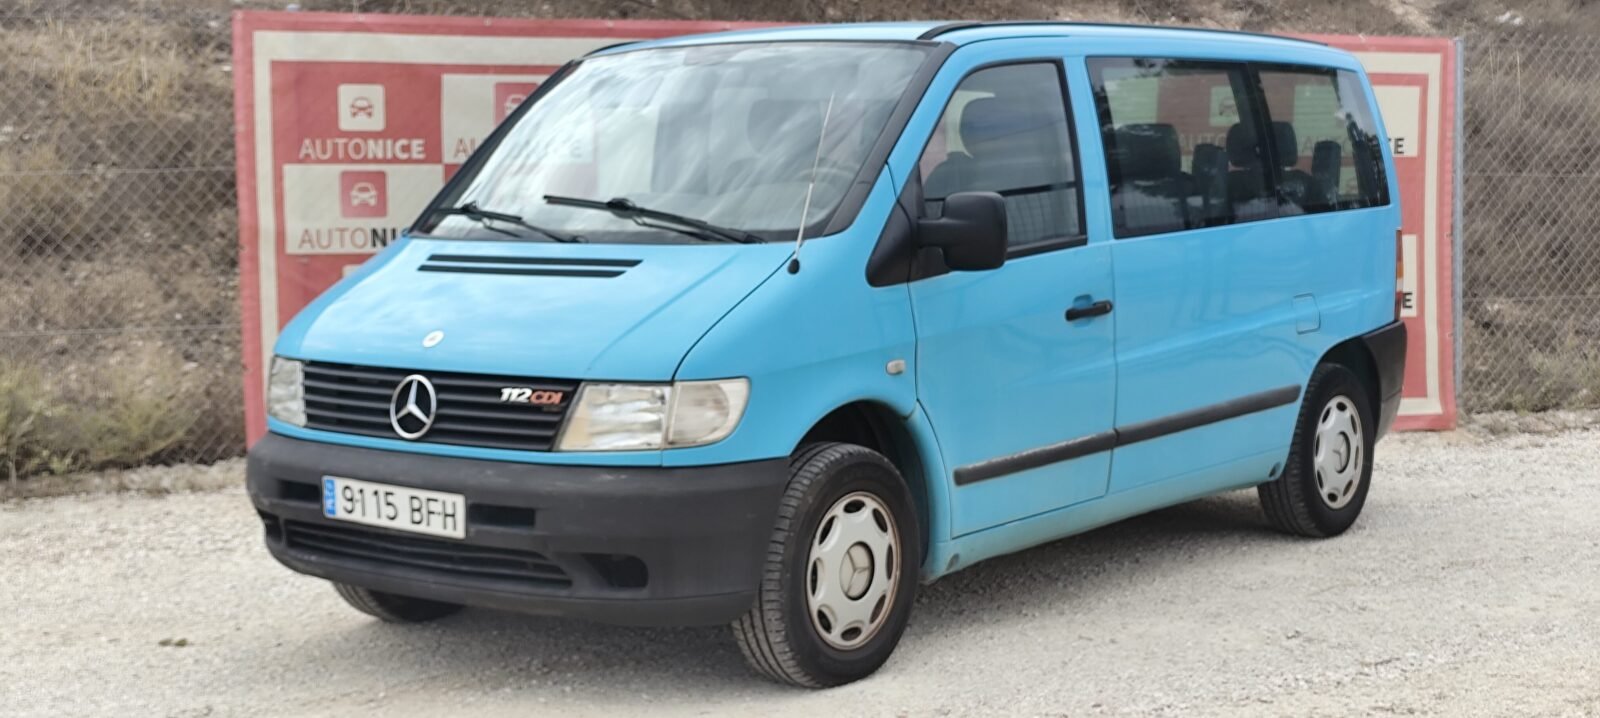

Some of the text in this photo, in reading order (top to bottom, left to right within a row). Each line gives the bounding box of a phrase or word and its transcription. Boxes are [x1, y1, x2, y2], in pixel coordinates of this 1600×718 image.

[299, 138, 426, 160] AUTONICE
[298, 227, 398, 249] AUTONI
[342, 485, 398, 520] 9115
[409, 495, 457, 531] BFH
